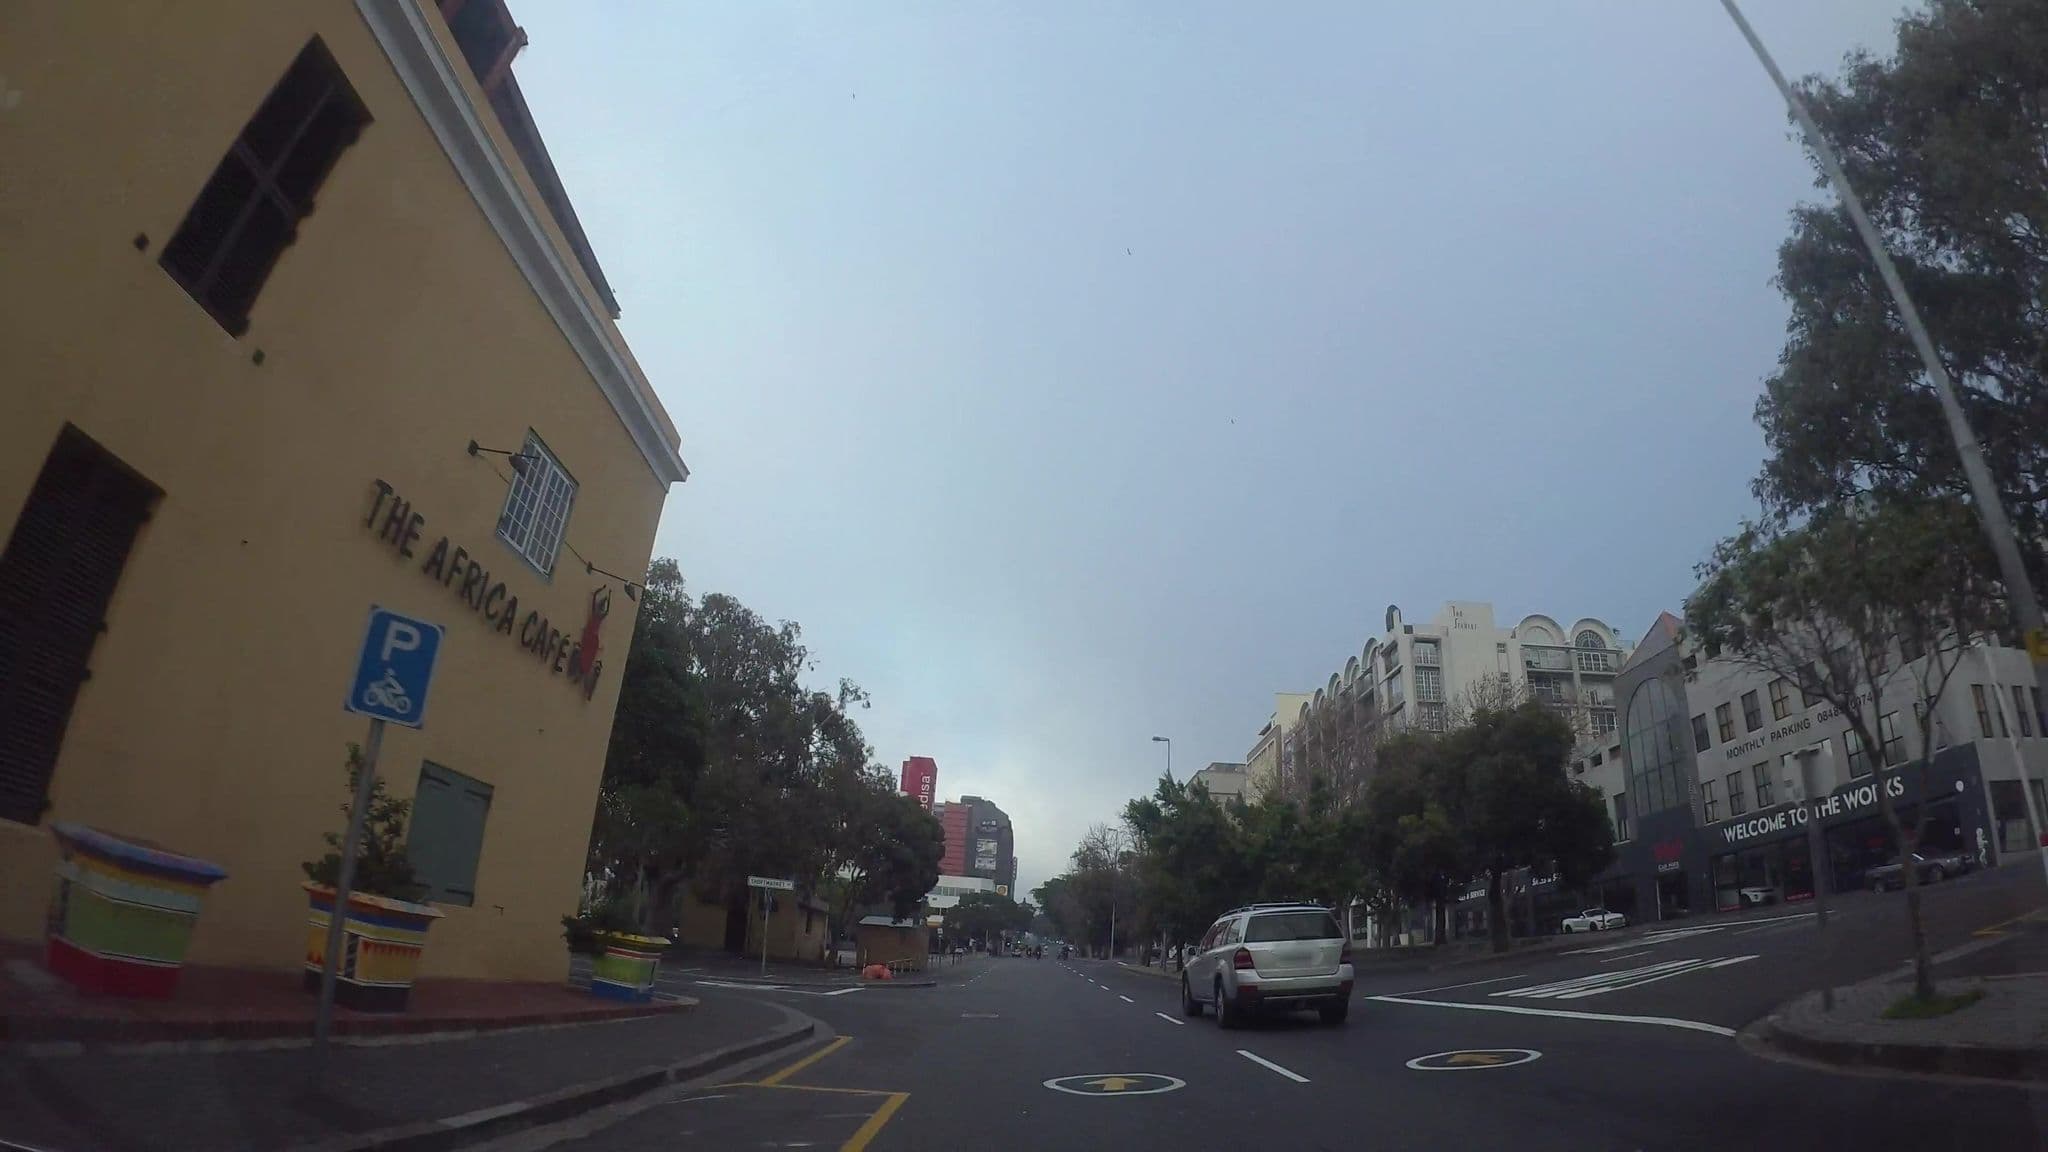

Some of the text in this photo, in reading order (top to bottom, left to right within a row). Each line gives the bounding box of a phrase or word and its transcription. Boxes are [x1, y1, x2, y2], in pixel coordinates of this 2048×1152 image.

[362, 478, 570, 673] THE AFRICA CAFÉ
[381, 621, 421, 660] P
[1726, 736, 1765, 760] MONTHLY
[1770, 718, 1810, 742] PARKING
[1724, 811, 1786, 843] WELCOME
[1789, 807, 1809, 827] TO
